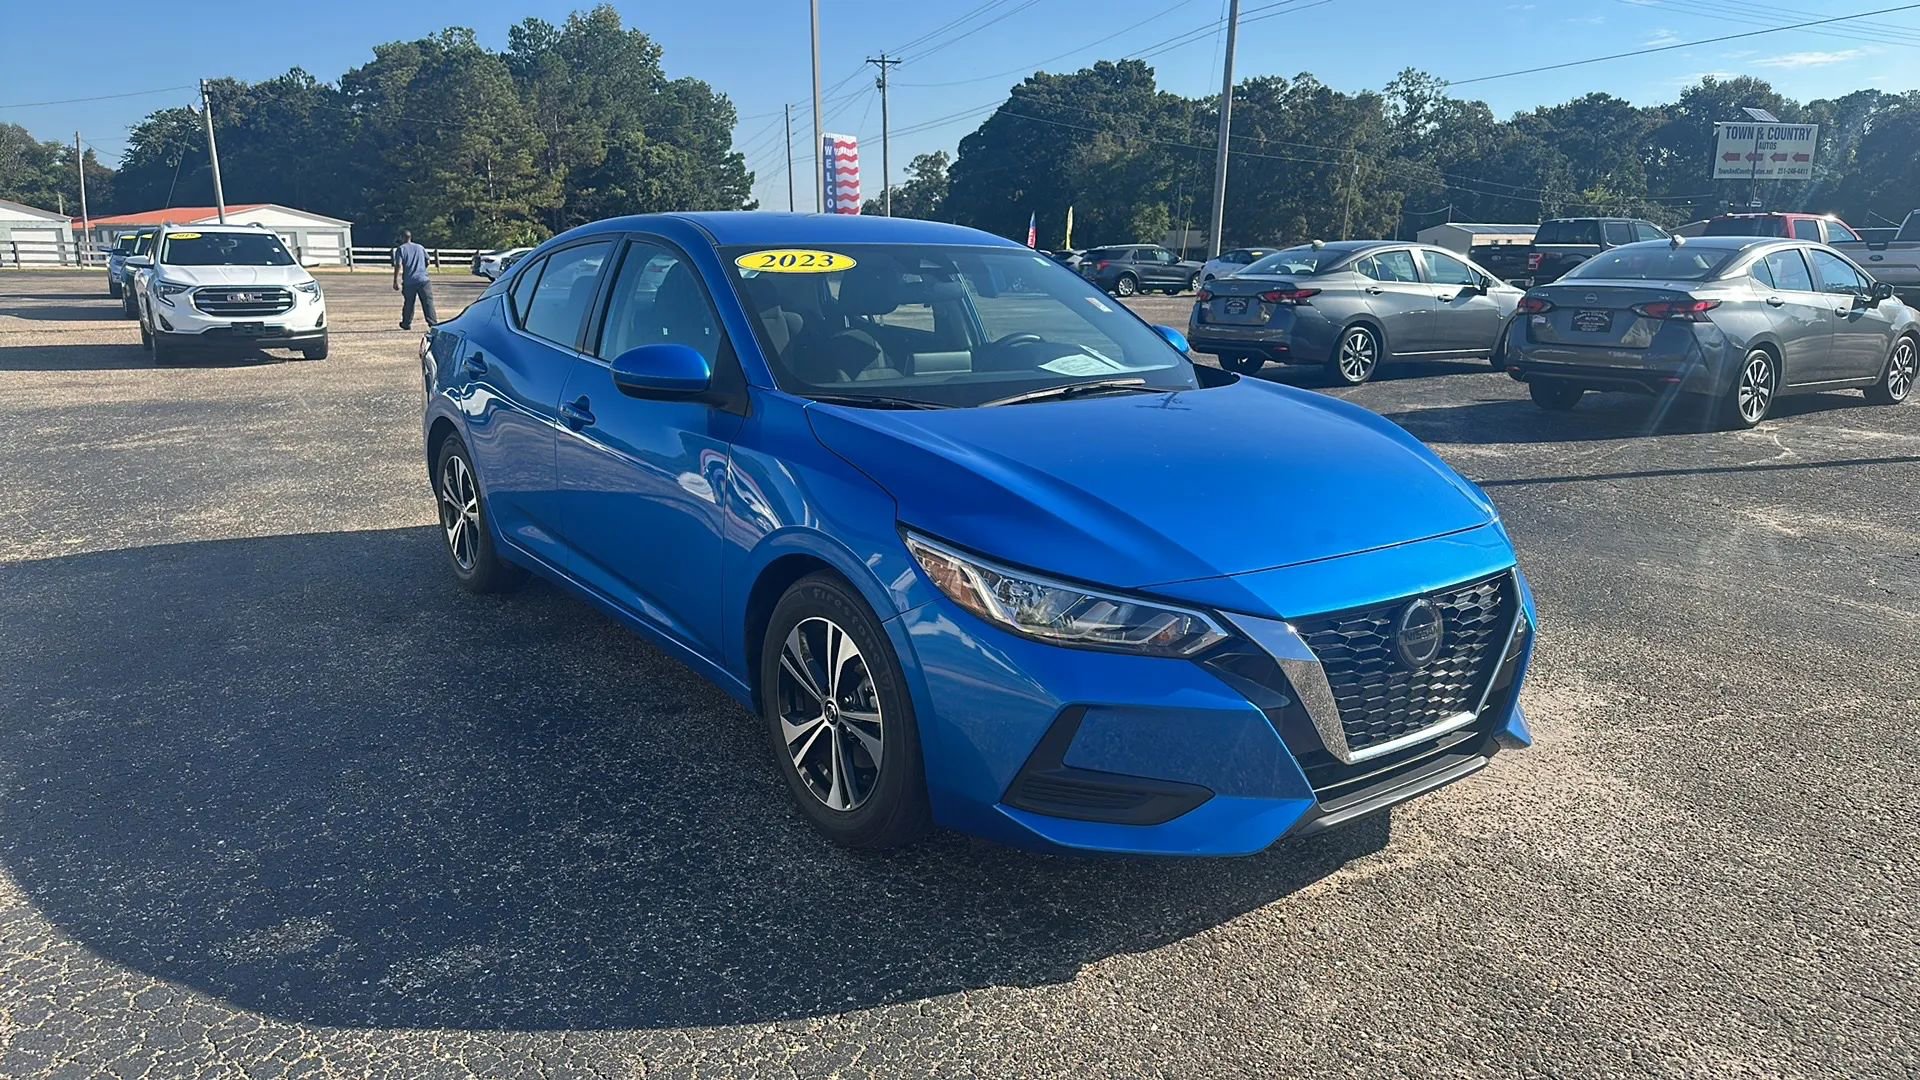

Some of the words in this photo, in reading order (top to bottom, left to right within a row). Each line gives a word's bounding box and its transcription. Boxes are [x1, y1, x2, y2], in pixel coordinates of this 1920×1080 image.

[1725, 126, 1754, 140] TOWN
[1757, 127, 1764, 140] &
[1767, 127, 1812, 141] COUNTRY
[1758, 142, 1777, 150] AUTOS
[824, 145, 834, 214] WELCO
[759, 254, 835, 268] 2023
[226, 291, 263, 304] GMC
[1404, 625, 1439, 642] NISSAN
